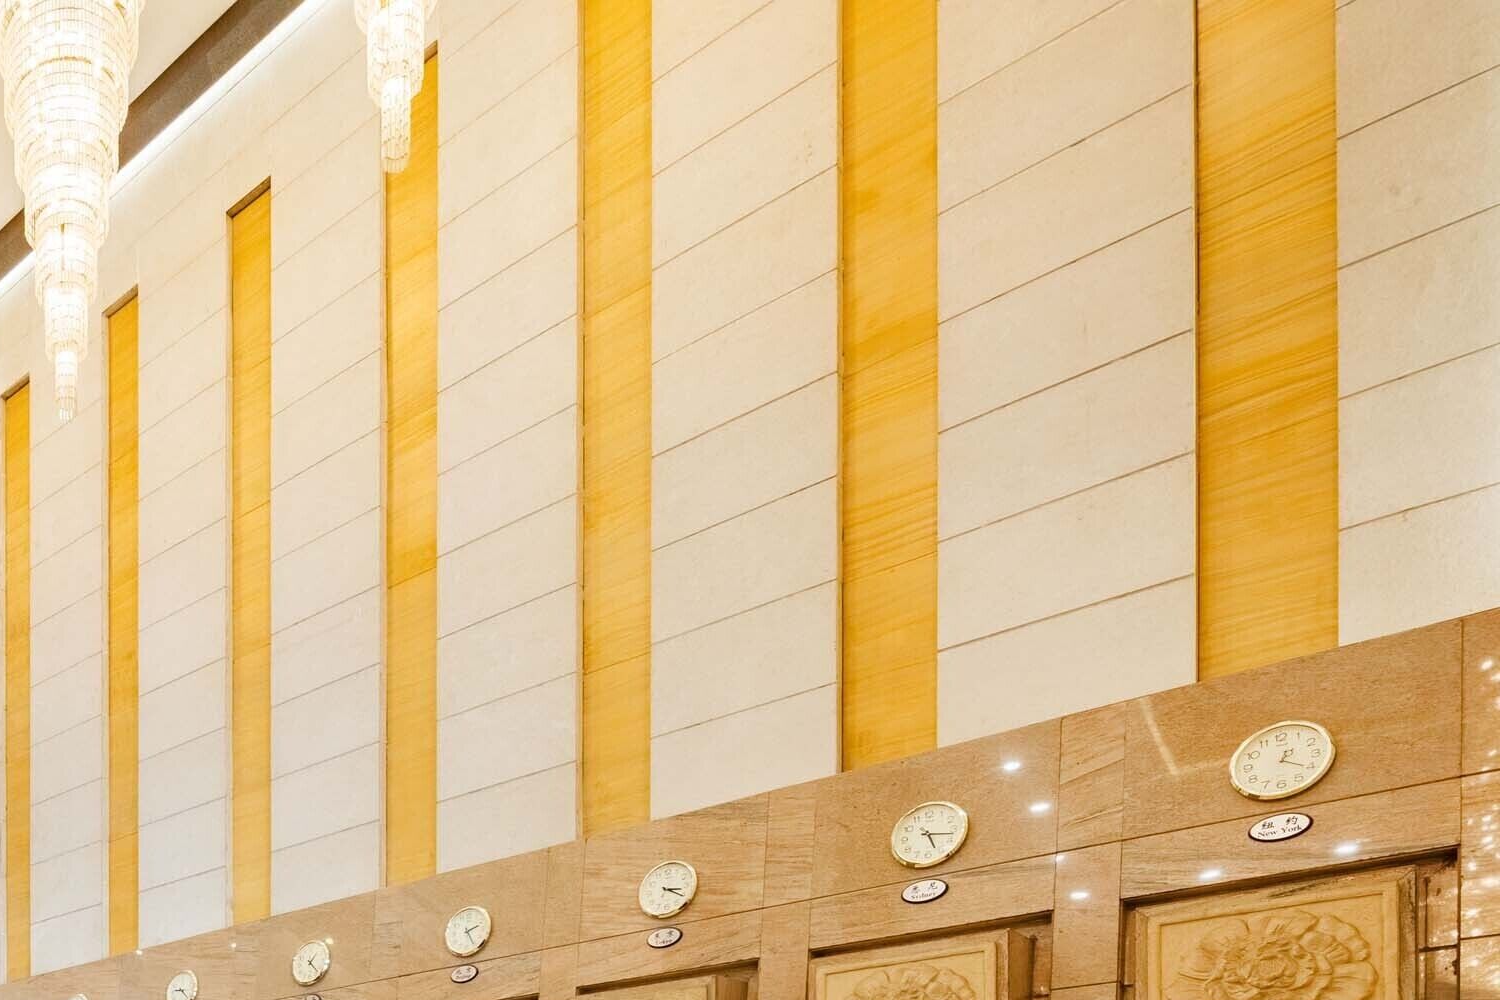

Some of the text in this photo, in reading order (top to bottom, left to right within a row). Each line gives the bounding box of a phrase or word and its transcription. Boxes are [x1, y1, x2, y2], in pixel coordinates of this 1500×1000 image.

[1275, 732, 1287, 742] 12
[1260, 739, 1269, 749] 11
[1307, 738, 1316, 747] 2
[1247, 750, 1260, 760] 10
[1311, 748, 1320, 758] 3
[1243, 763, 1253, 773] 9
[1306, 761, 1315, 769] 4
[1248, 775, 1258, 784] 8
[1294, 773, 1304, 782] 5
[1260, 780, 1270, 789] 7
[1276, 780, 1287, 789] 6
[1261, 815, 1299, 829] 纽约
[1257, 825, 1303, 838] New York
